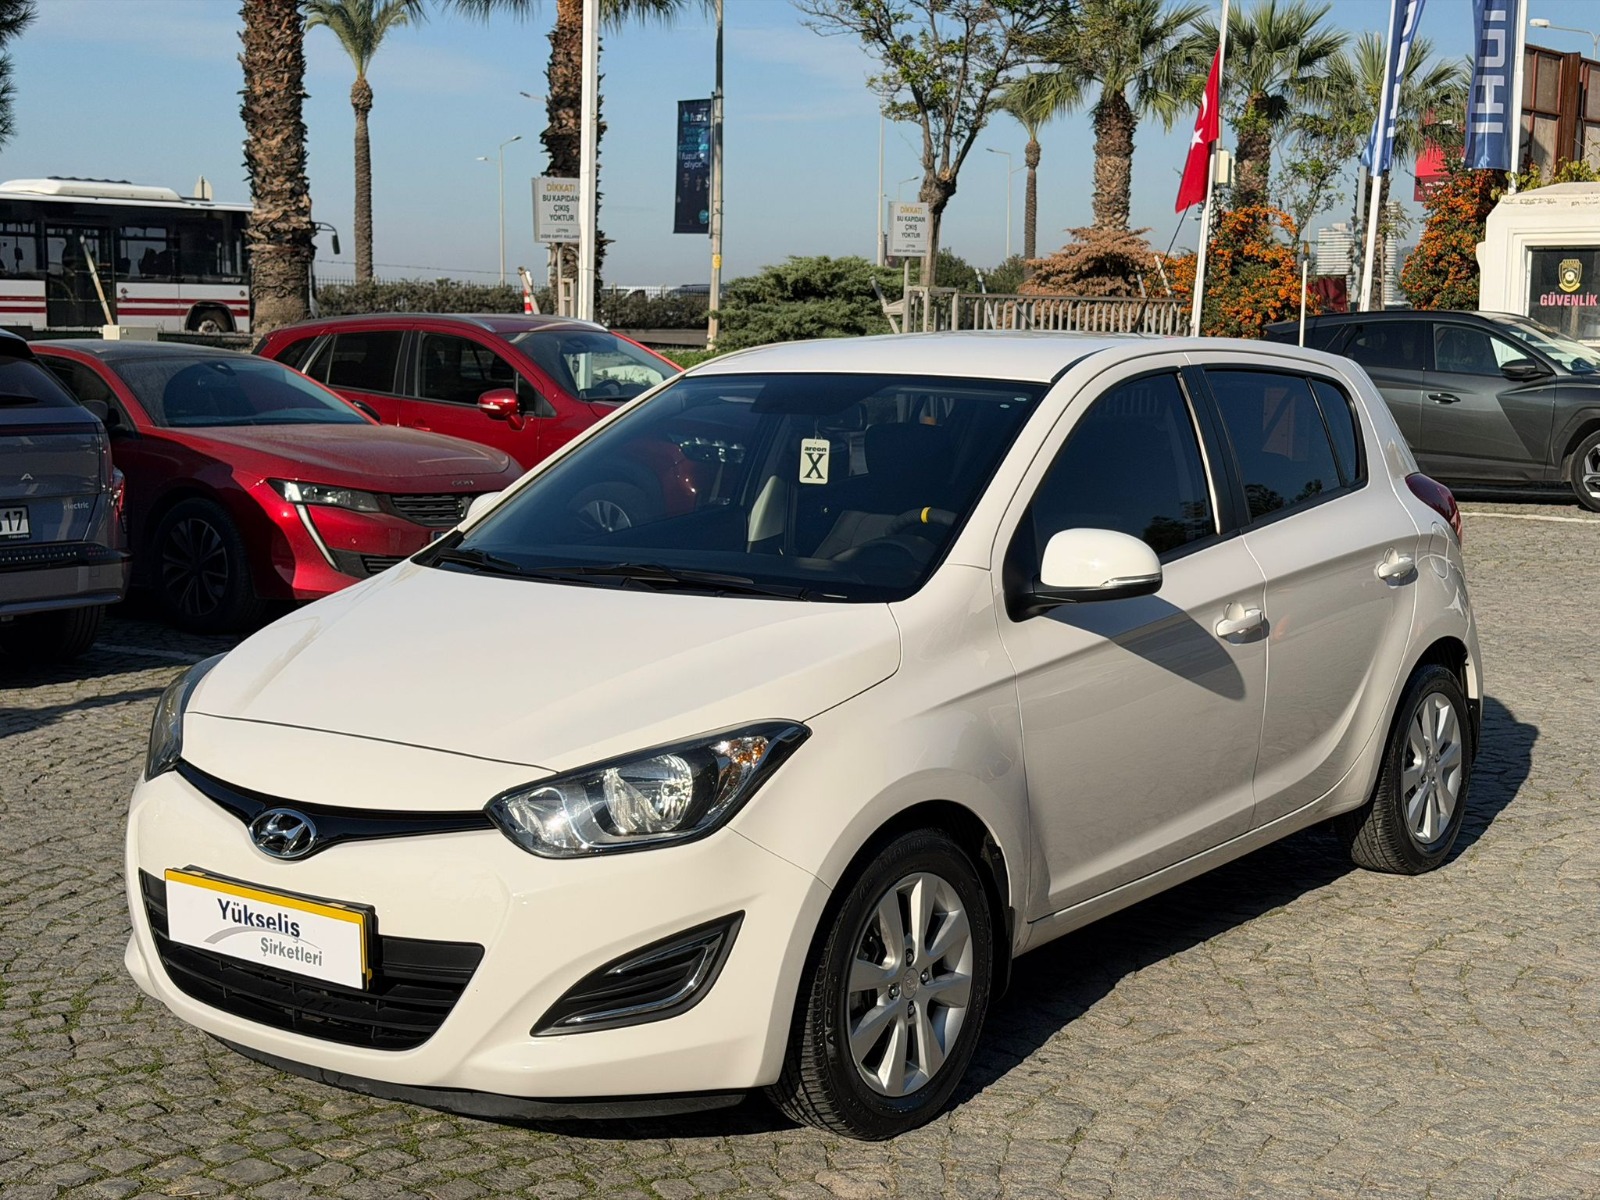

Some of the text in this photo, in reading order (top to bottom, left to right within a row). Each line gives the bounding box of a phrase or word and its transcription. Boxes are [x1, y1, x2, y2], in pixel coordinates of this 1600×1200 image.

[542, 194, 552, 202] BU
[553, 204, 570, 213] ÇIKIŞ
[549, 214, 575, 222] YOKTUR
[1540, 291, 1598, 306] GÜVENLİK
[803, 452, 826, 480] X
[63, 502, 89, 511] electric
[217, 897, 301, 944] Yükseliş
[260, 936, 323, 967] Şirketleri
